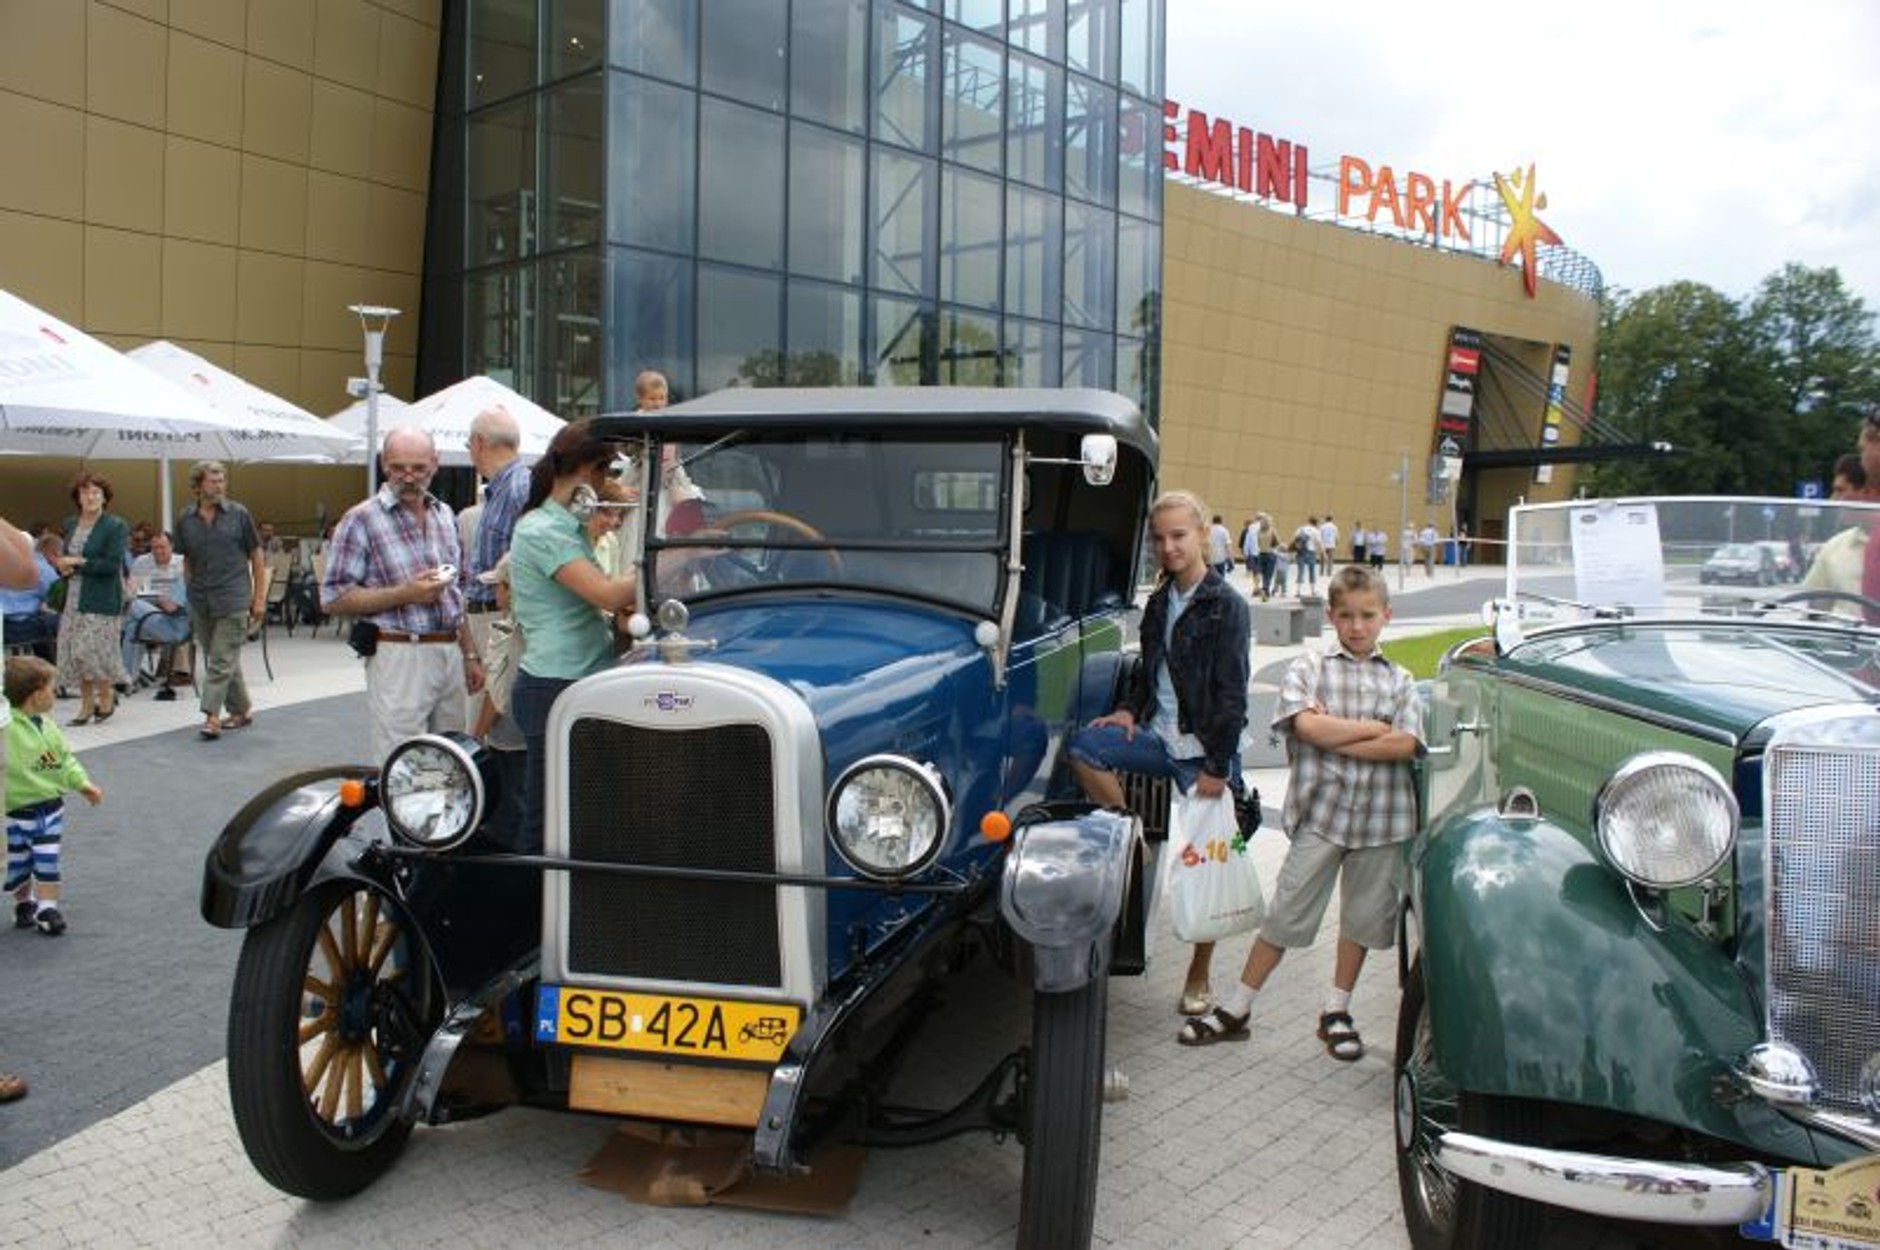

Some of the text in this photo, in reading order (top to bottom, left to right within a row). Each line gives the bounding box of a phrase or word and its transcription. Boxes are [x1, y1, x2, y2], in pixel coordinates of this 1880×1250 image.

[1339, 154, 1474, 242] PARK
[1804, 482, 1819, 498] P
[539, 993, 728, 1052] PL SB 42A
